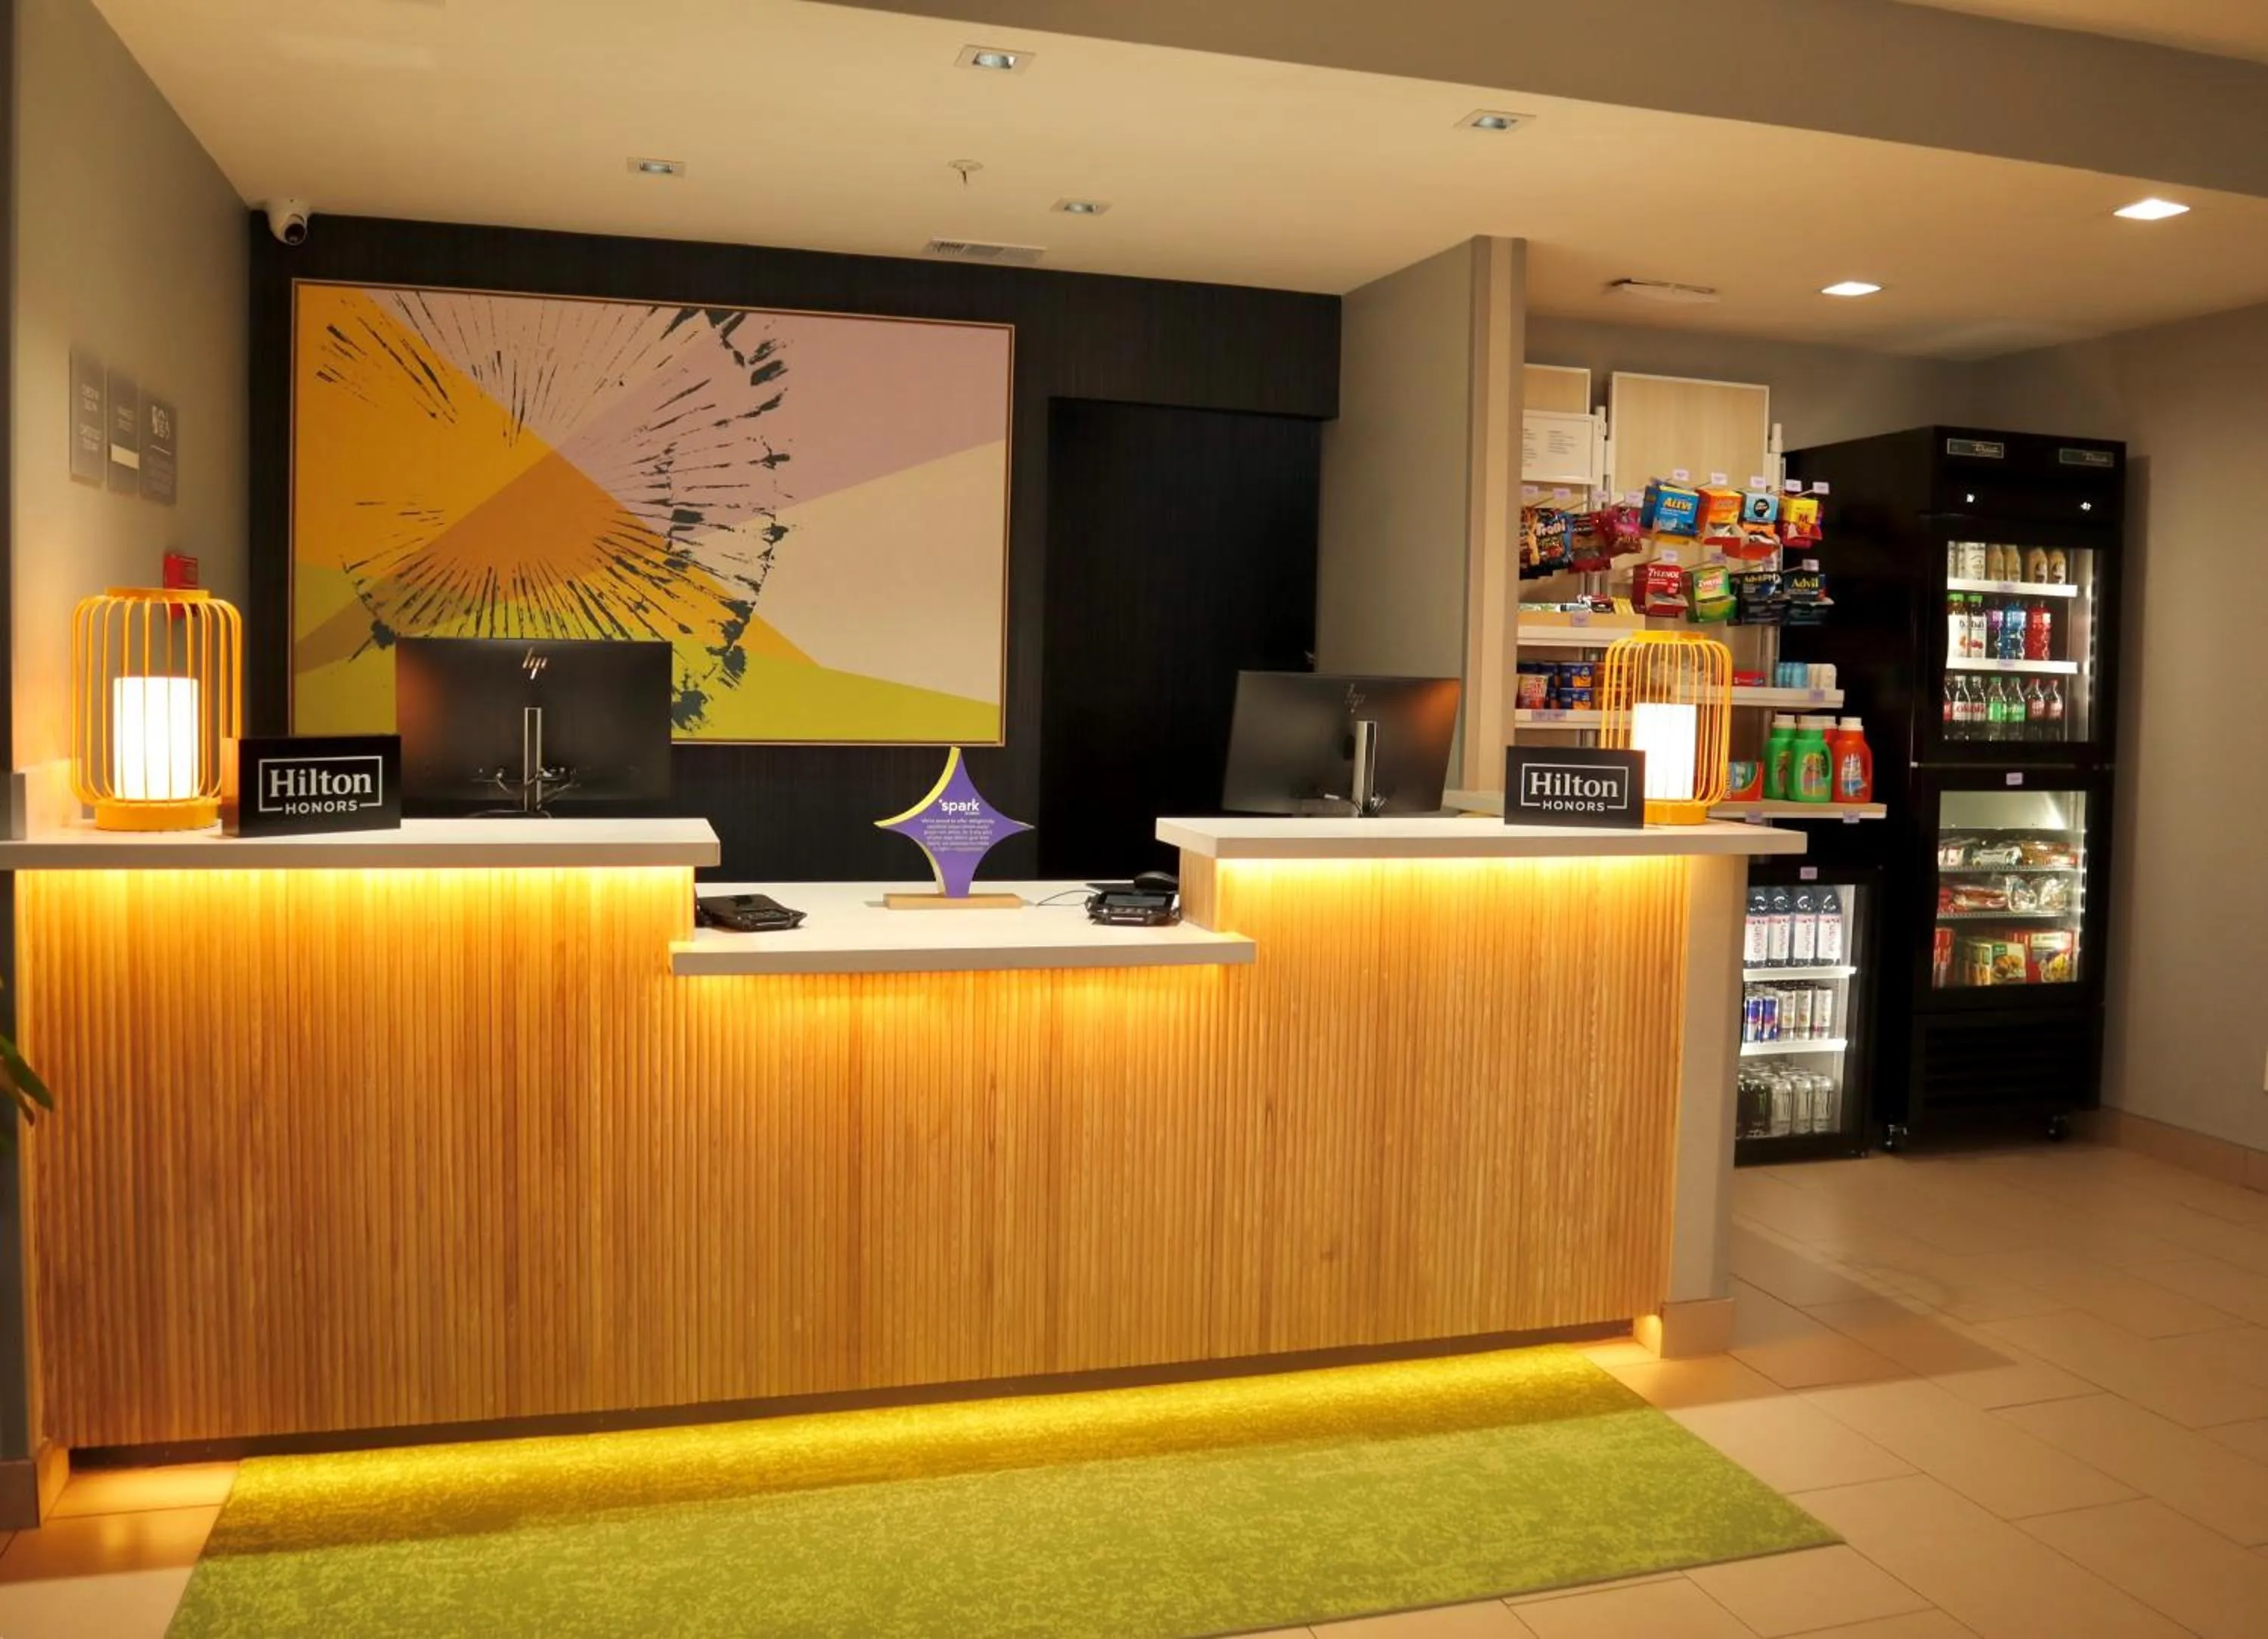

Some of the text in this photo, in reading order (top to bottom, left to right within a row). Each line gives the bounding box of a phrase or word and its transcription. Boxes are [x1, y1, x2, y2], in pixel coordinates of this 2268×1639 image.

[1791, 577, 1819, 587] Advil
[522, 646, 548, 680] hp
[269, 768, 373, 798] Hilton
[1530, 771, 1619, 798] Hilton
[285, 799, 358, 814] HONORS
[941, 798, 981, 816] spark
[1542, 800, 1606, 812] HONORS
